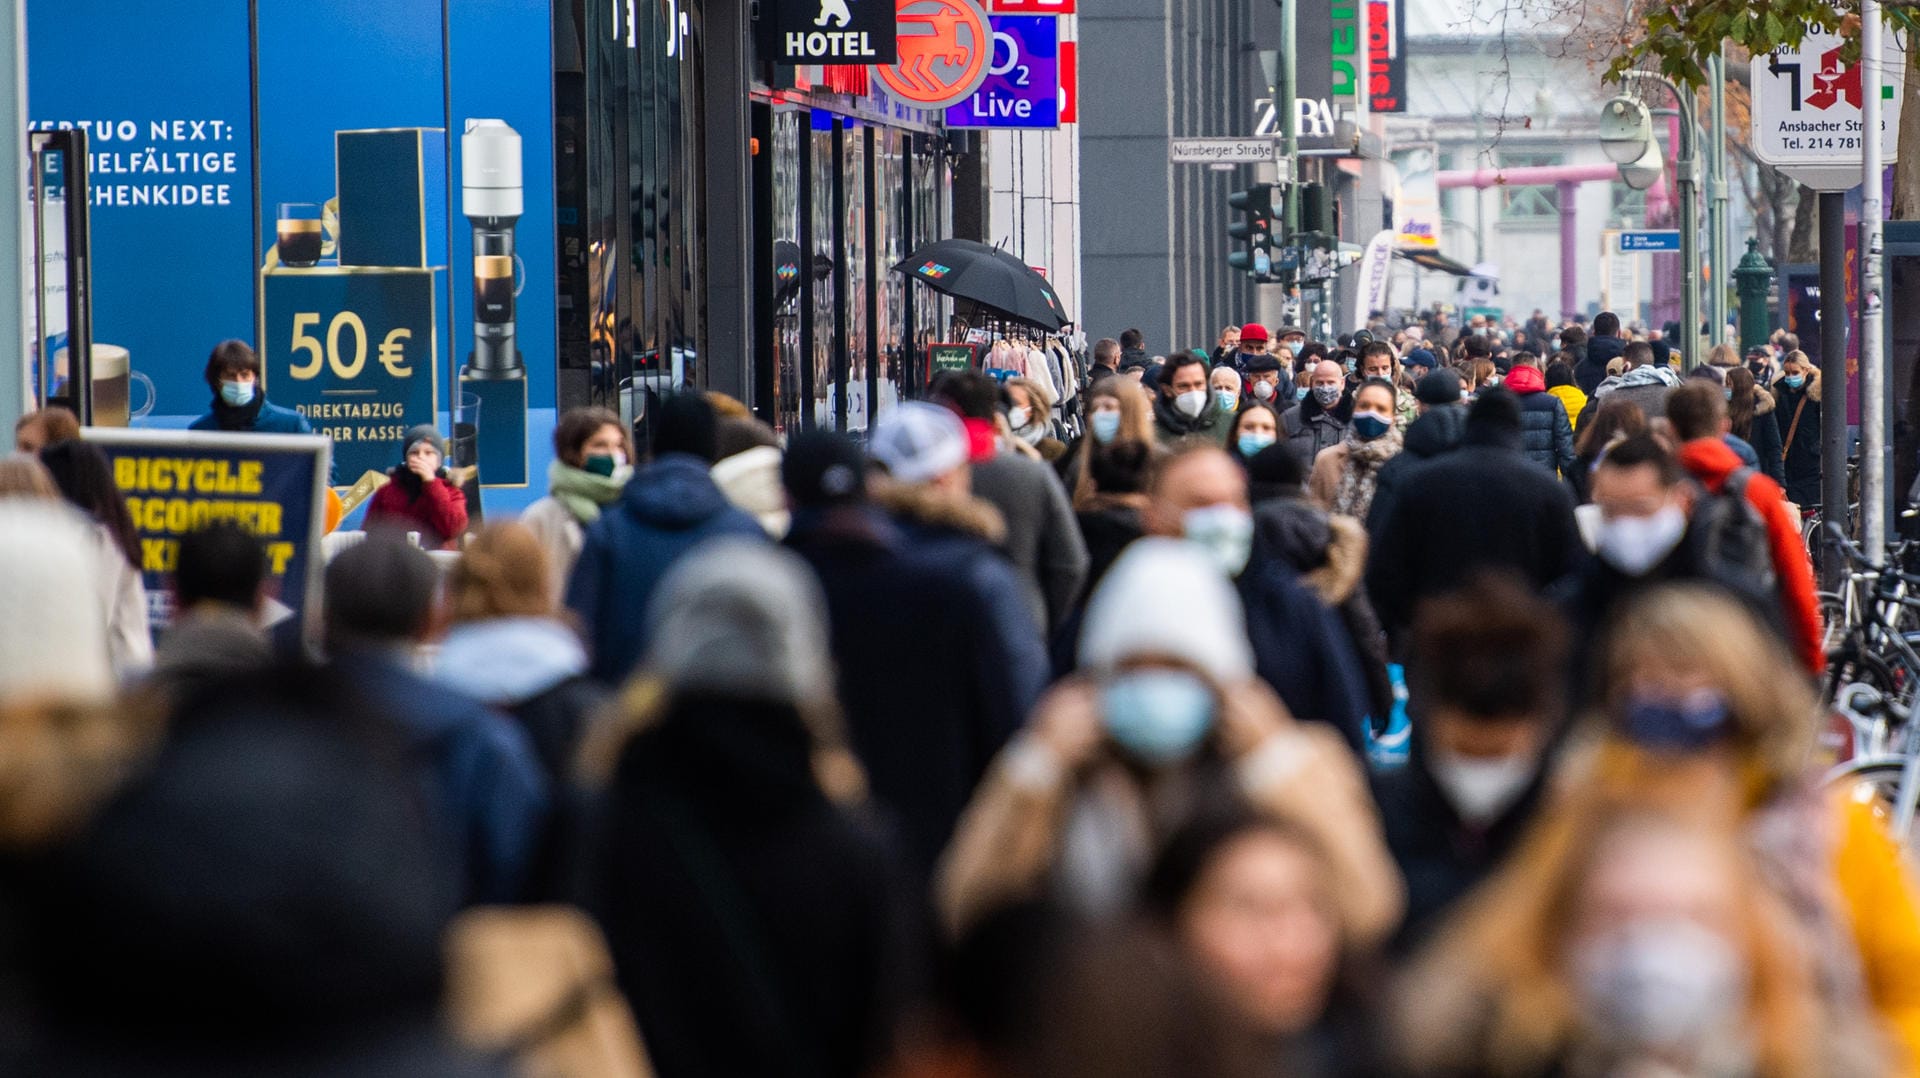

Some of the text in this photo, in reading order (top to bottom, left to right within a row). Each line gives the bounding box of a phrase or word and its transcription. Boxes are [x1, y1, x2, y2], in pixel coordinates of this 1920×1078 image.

[786, 31, 876, 57] HOTEL
[1332, 0, 1355, 95] DEI
[973, 91, 1032, 118] Live
[1254, 98, 1335, 138] ZRA
[1779, 119, 1864, 132] Ansbacher Str
[150, 120, 234, 141] NEXT:
[1173, 143, 1271, 158] Nürnberger Straße
[1782, 137, 1861, 150] Tel. 214 781
[88, 147, 237, 173] IELFÄLTIGE
[27, 184, 231, 206] EHENKIDEE
[289, 310, 413, 380] 50 €
[296, 403, 404, 419] DIREKTABZUG
[322, 426, 353, 442] DER
[113, 456, 264, 494] BICYCLE
